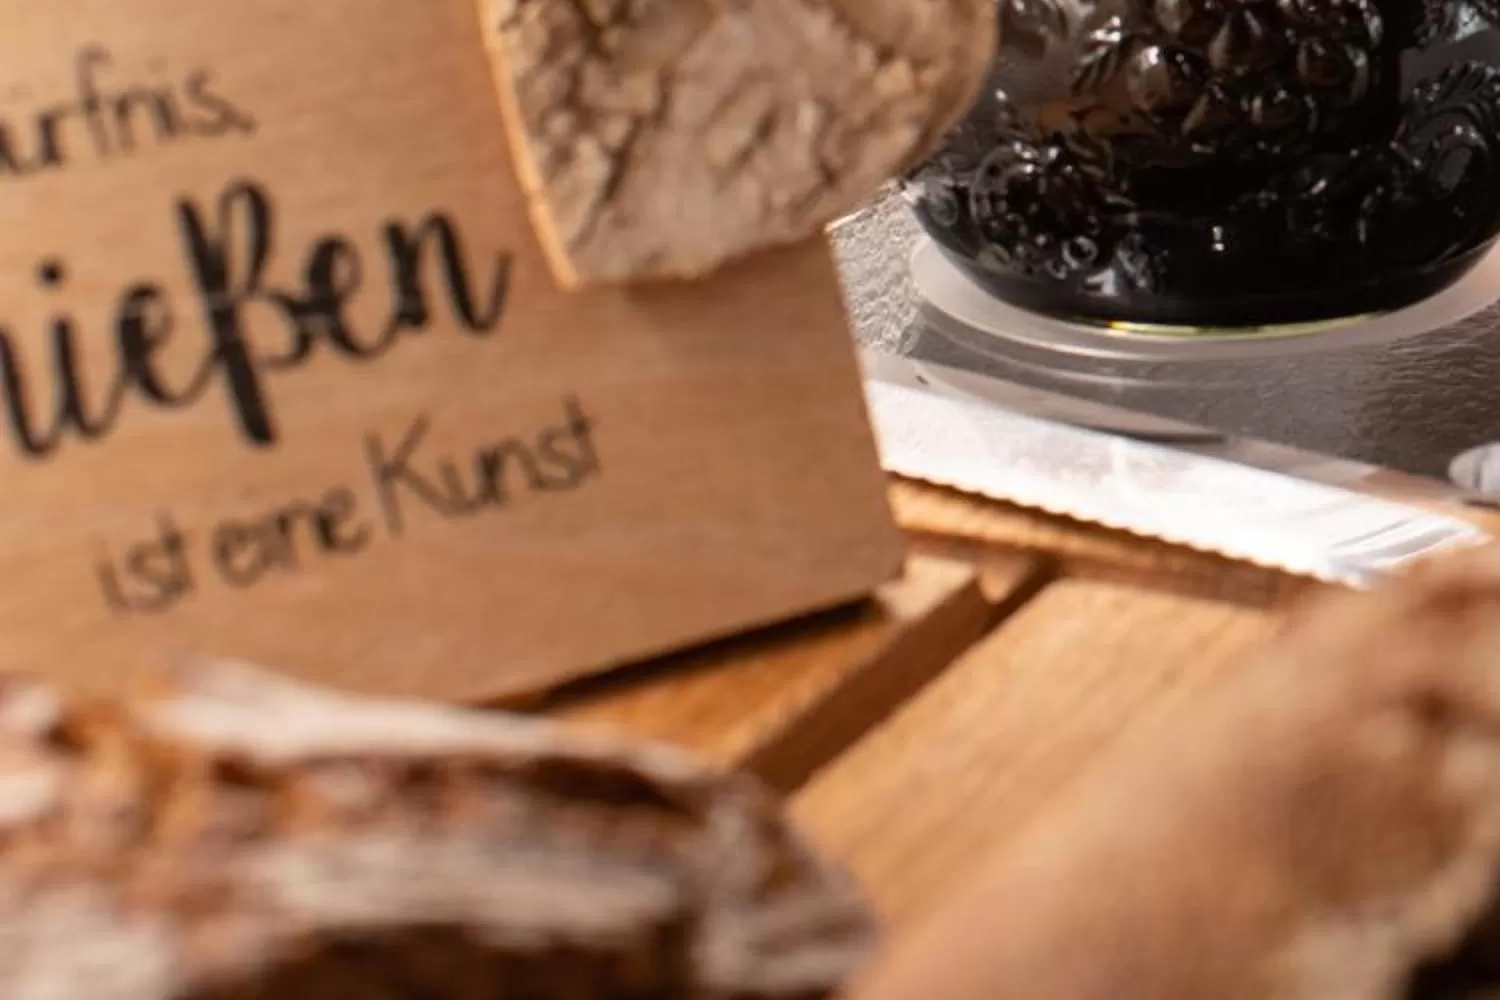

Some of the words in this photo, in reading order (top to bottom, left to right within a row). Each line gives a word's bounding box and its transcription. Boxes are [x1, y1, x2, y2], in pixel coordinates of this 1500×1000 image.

[96, 510, 194, 618] ist
[212, 485, 372, 588] eine
[362, 394, 603, 538] Kunst
